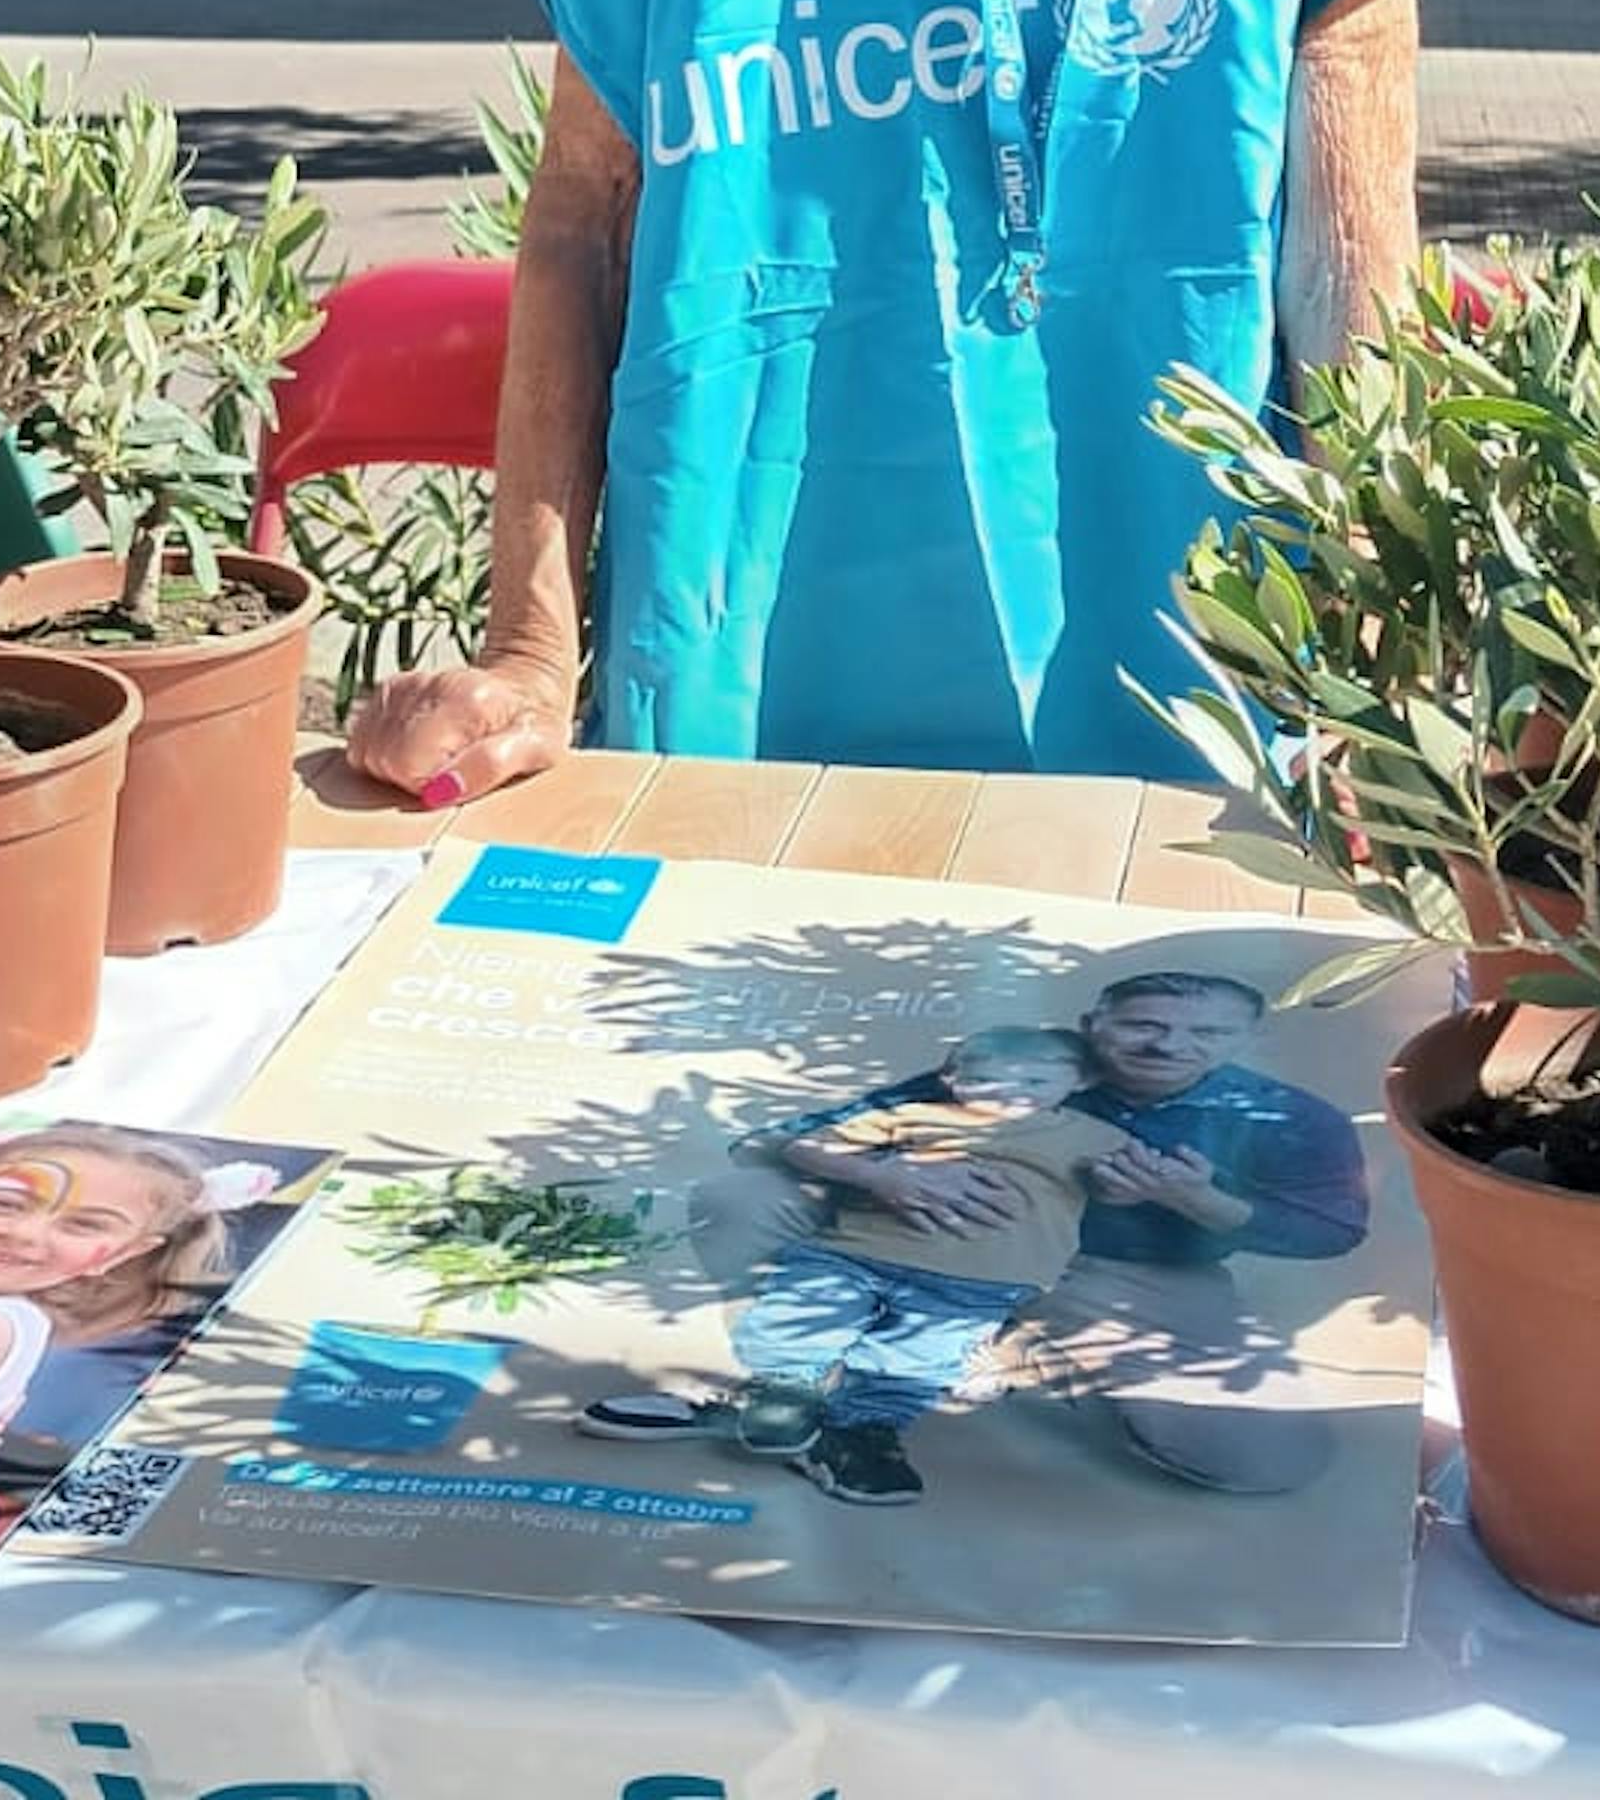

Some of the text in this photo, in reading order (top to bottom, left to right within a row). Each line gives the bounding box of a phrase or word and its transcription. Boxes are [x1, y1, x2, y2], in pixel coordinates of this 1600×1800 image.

[390, 968, 516, 1009] che
[351, 1474, 533, 1499] settembre
[539, 1485, 576, 1503] al
[580, 1489, 608, 1509] 2
[613, 1495, 747, 1522] ottobre
